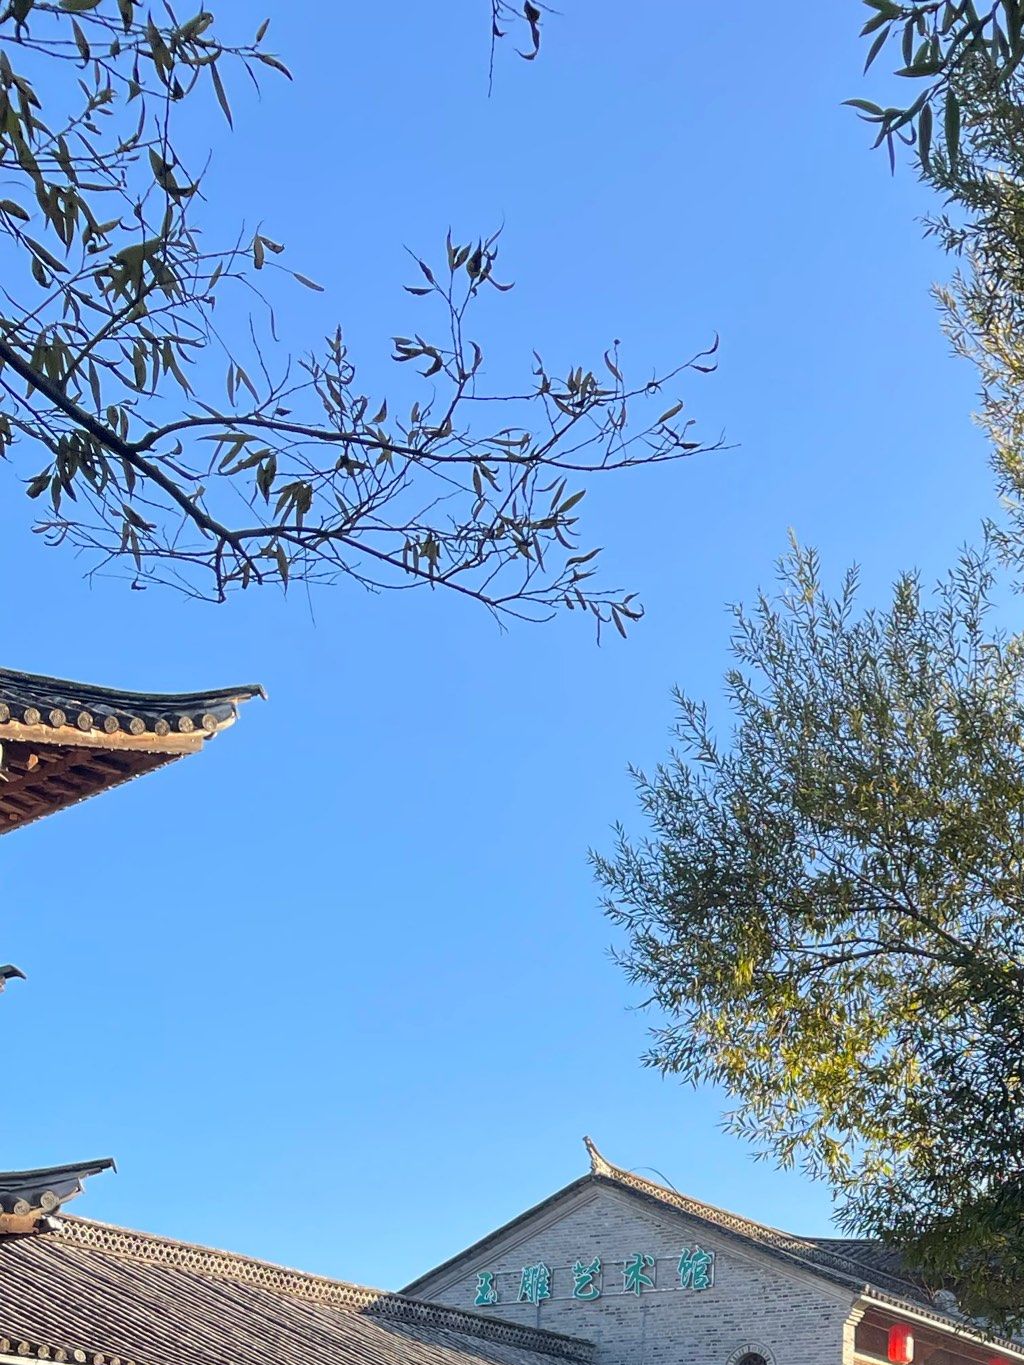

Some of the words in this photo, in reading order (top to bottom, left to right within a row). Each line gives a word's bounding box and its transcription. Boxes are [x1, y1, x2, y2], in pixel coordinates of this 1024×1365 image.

[474, 1245, 712, 1306] 玉雕艺术馆
